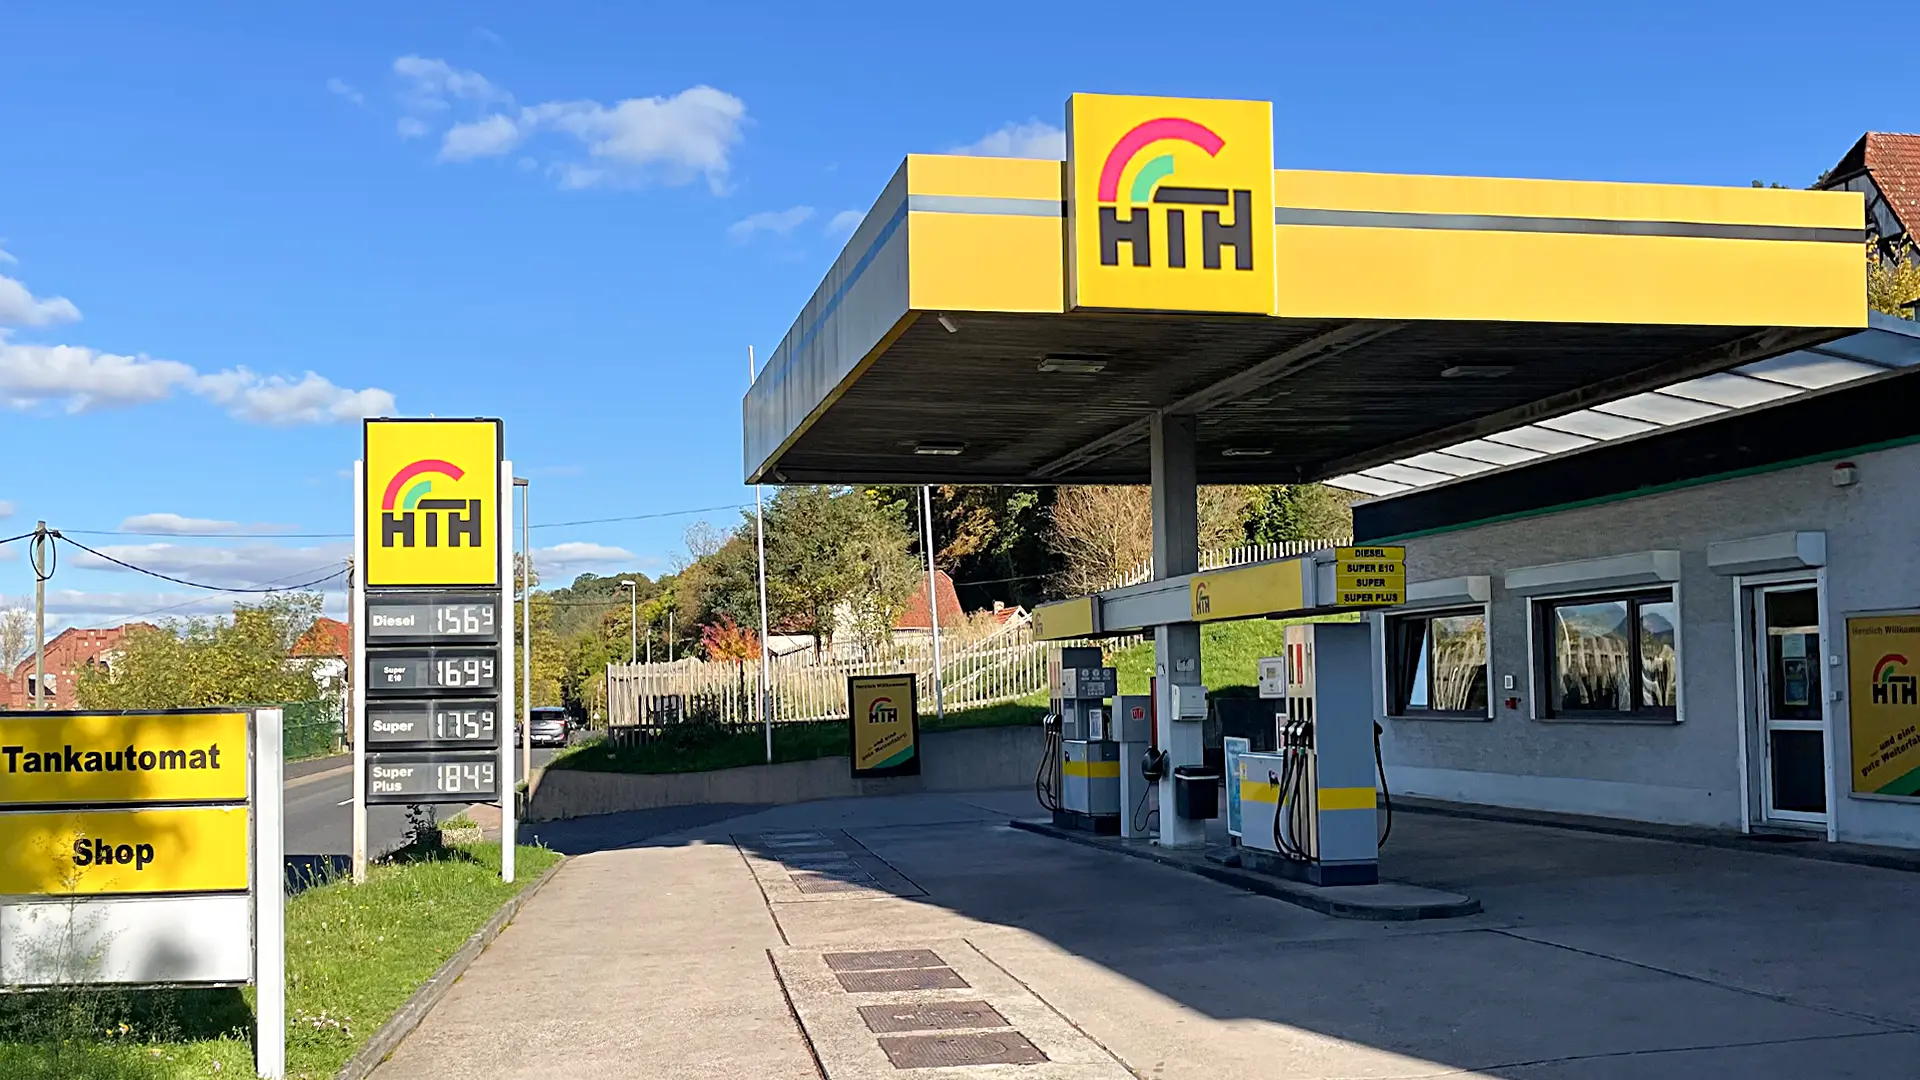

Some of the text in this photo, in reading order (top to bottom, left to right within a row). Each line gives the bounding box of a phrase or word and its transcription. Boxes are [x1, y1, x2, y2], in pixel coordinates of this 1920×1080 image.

[1098, 185, 1254, 271] HTH
[382, 499, 482, 547] HTH
[1355, 549, 1386, 557] DIESEL
[1347, 564, 1395, 572] SUPER E10
[1356, 579, 1386, 587] SUPER
[1344, 593, 1398, 602] SUPER PLUS
[373, 615, 415, 627] Diesel
[1852, 627, 1883, 635] Herzlich
[383, 666, 406, 675] Super
[387, 674, 402, 682] E10
[1872, 676, 1917, 705] HTH
[869, 708, 898, 723] HTH
[373, 720, 414, 733] Super
[1879, 735, 1895, 750] und
[1897, 725, 1916, 740] eine
[2, 743, 221, 773] Tankautomat
[373, 767, 414, 779] Super
[1862, 760, 1880, 777] gute
[373, 780, 402, 792] Plus
[73, 838, 155, 870] Shop
